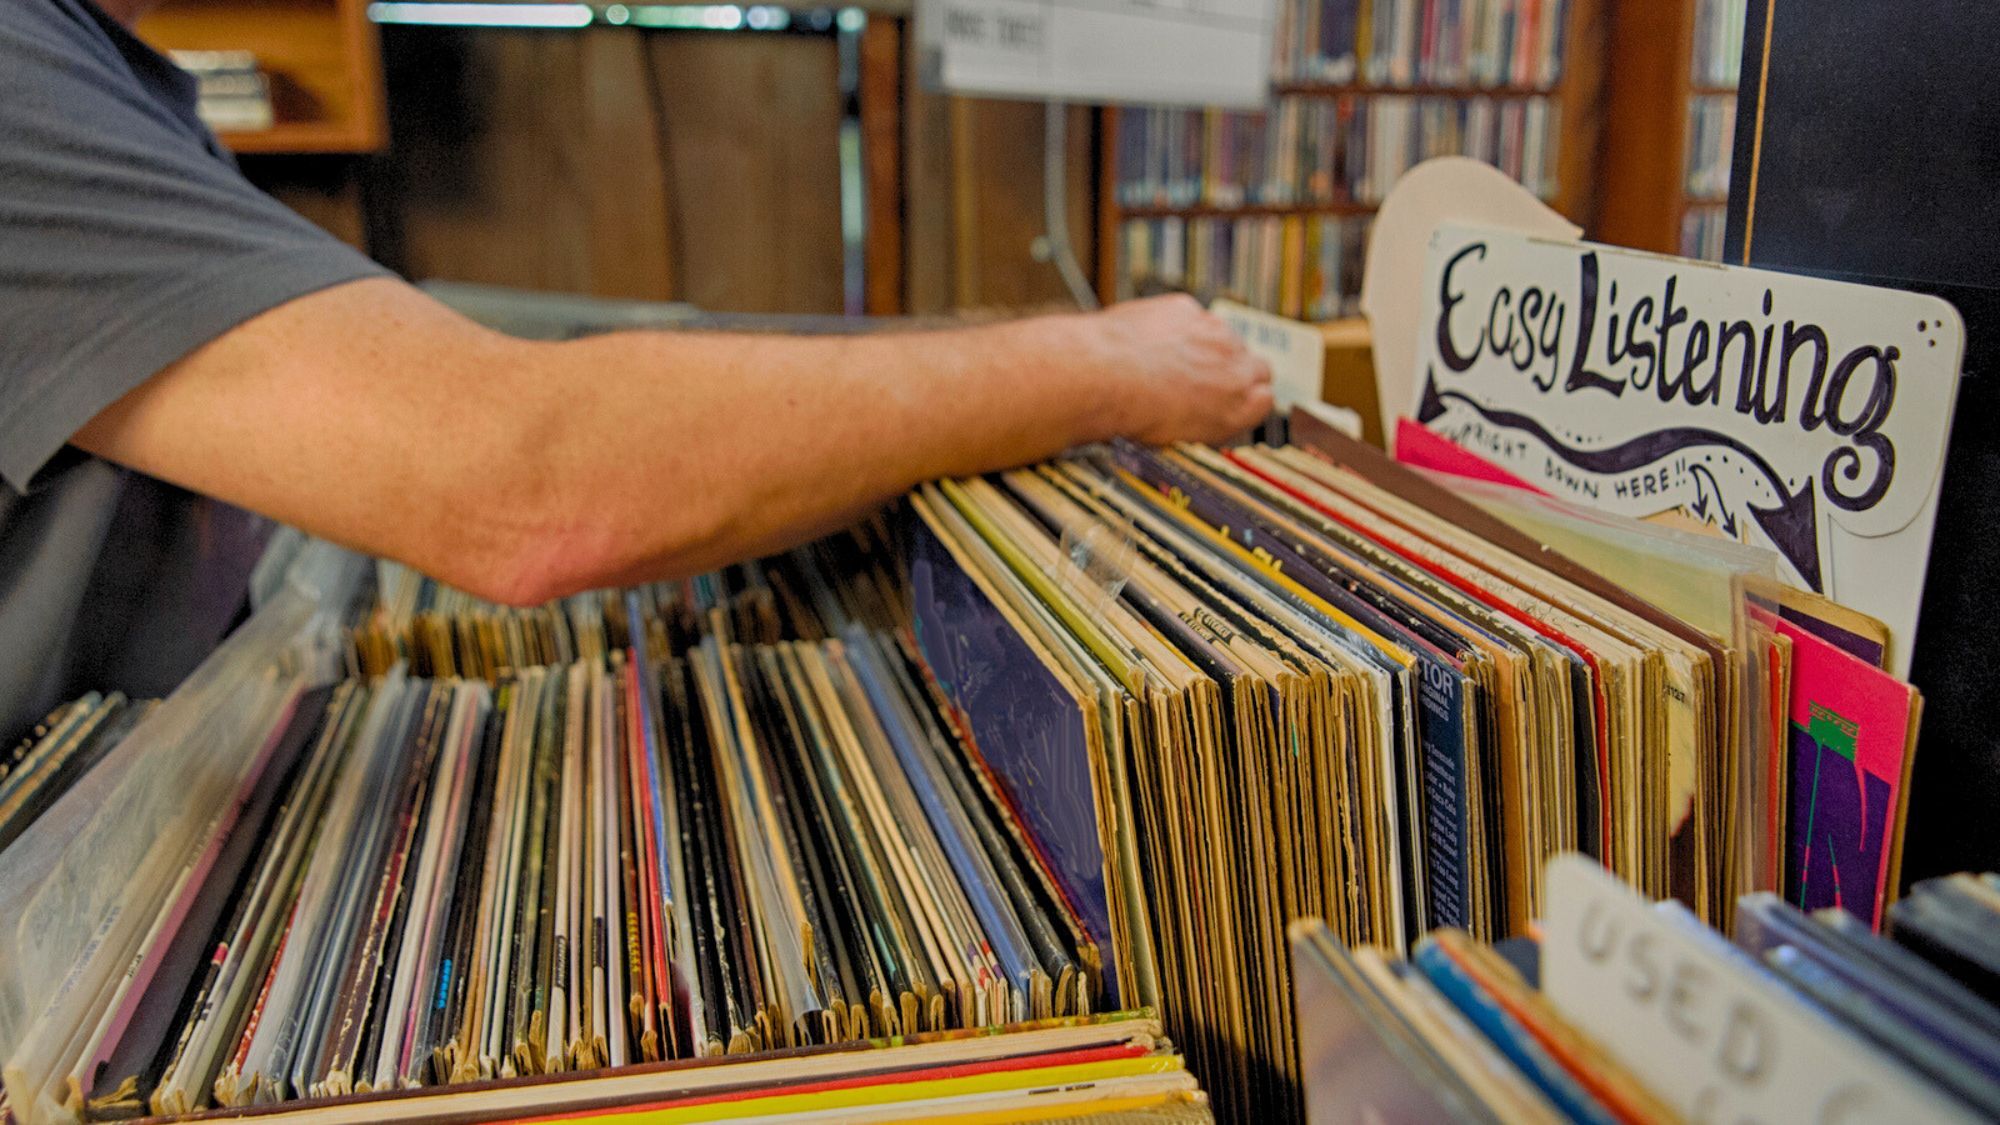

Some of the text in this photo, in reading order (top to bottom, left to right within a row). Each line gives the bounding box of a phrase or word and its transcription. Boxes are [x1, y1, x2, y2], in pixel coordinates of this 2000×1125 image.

[1437, 241, 1900, 513] Easy Listening
[1545, 457, 1599, 499] DOWN
[1615, 457, 1687, 499] HERE!!
[1576, 898, 1780, 1086] USED
